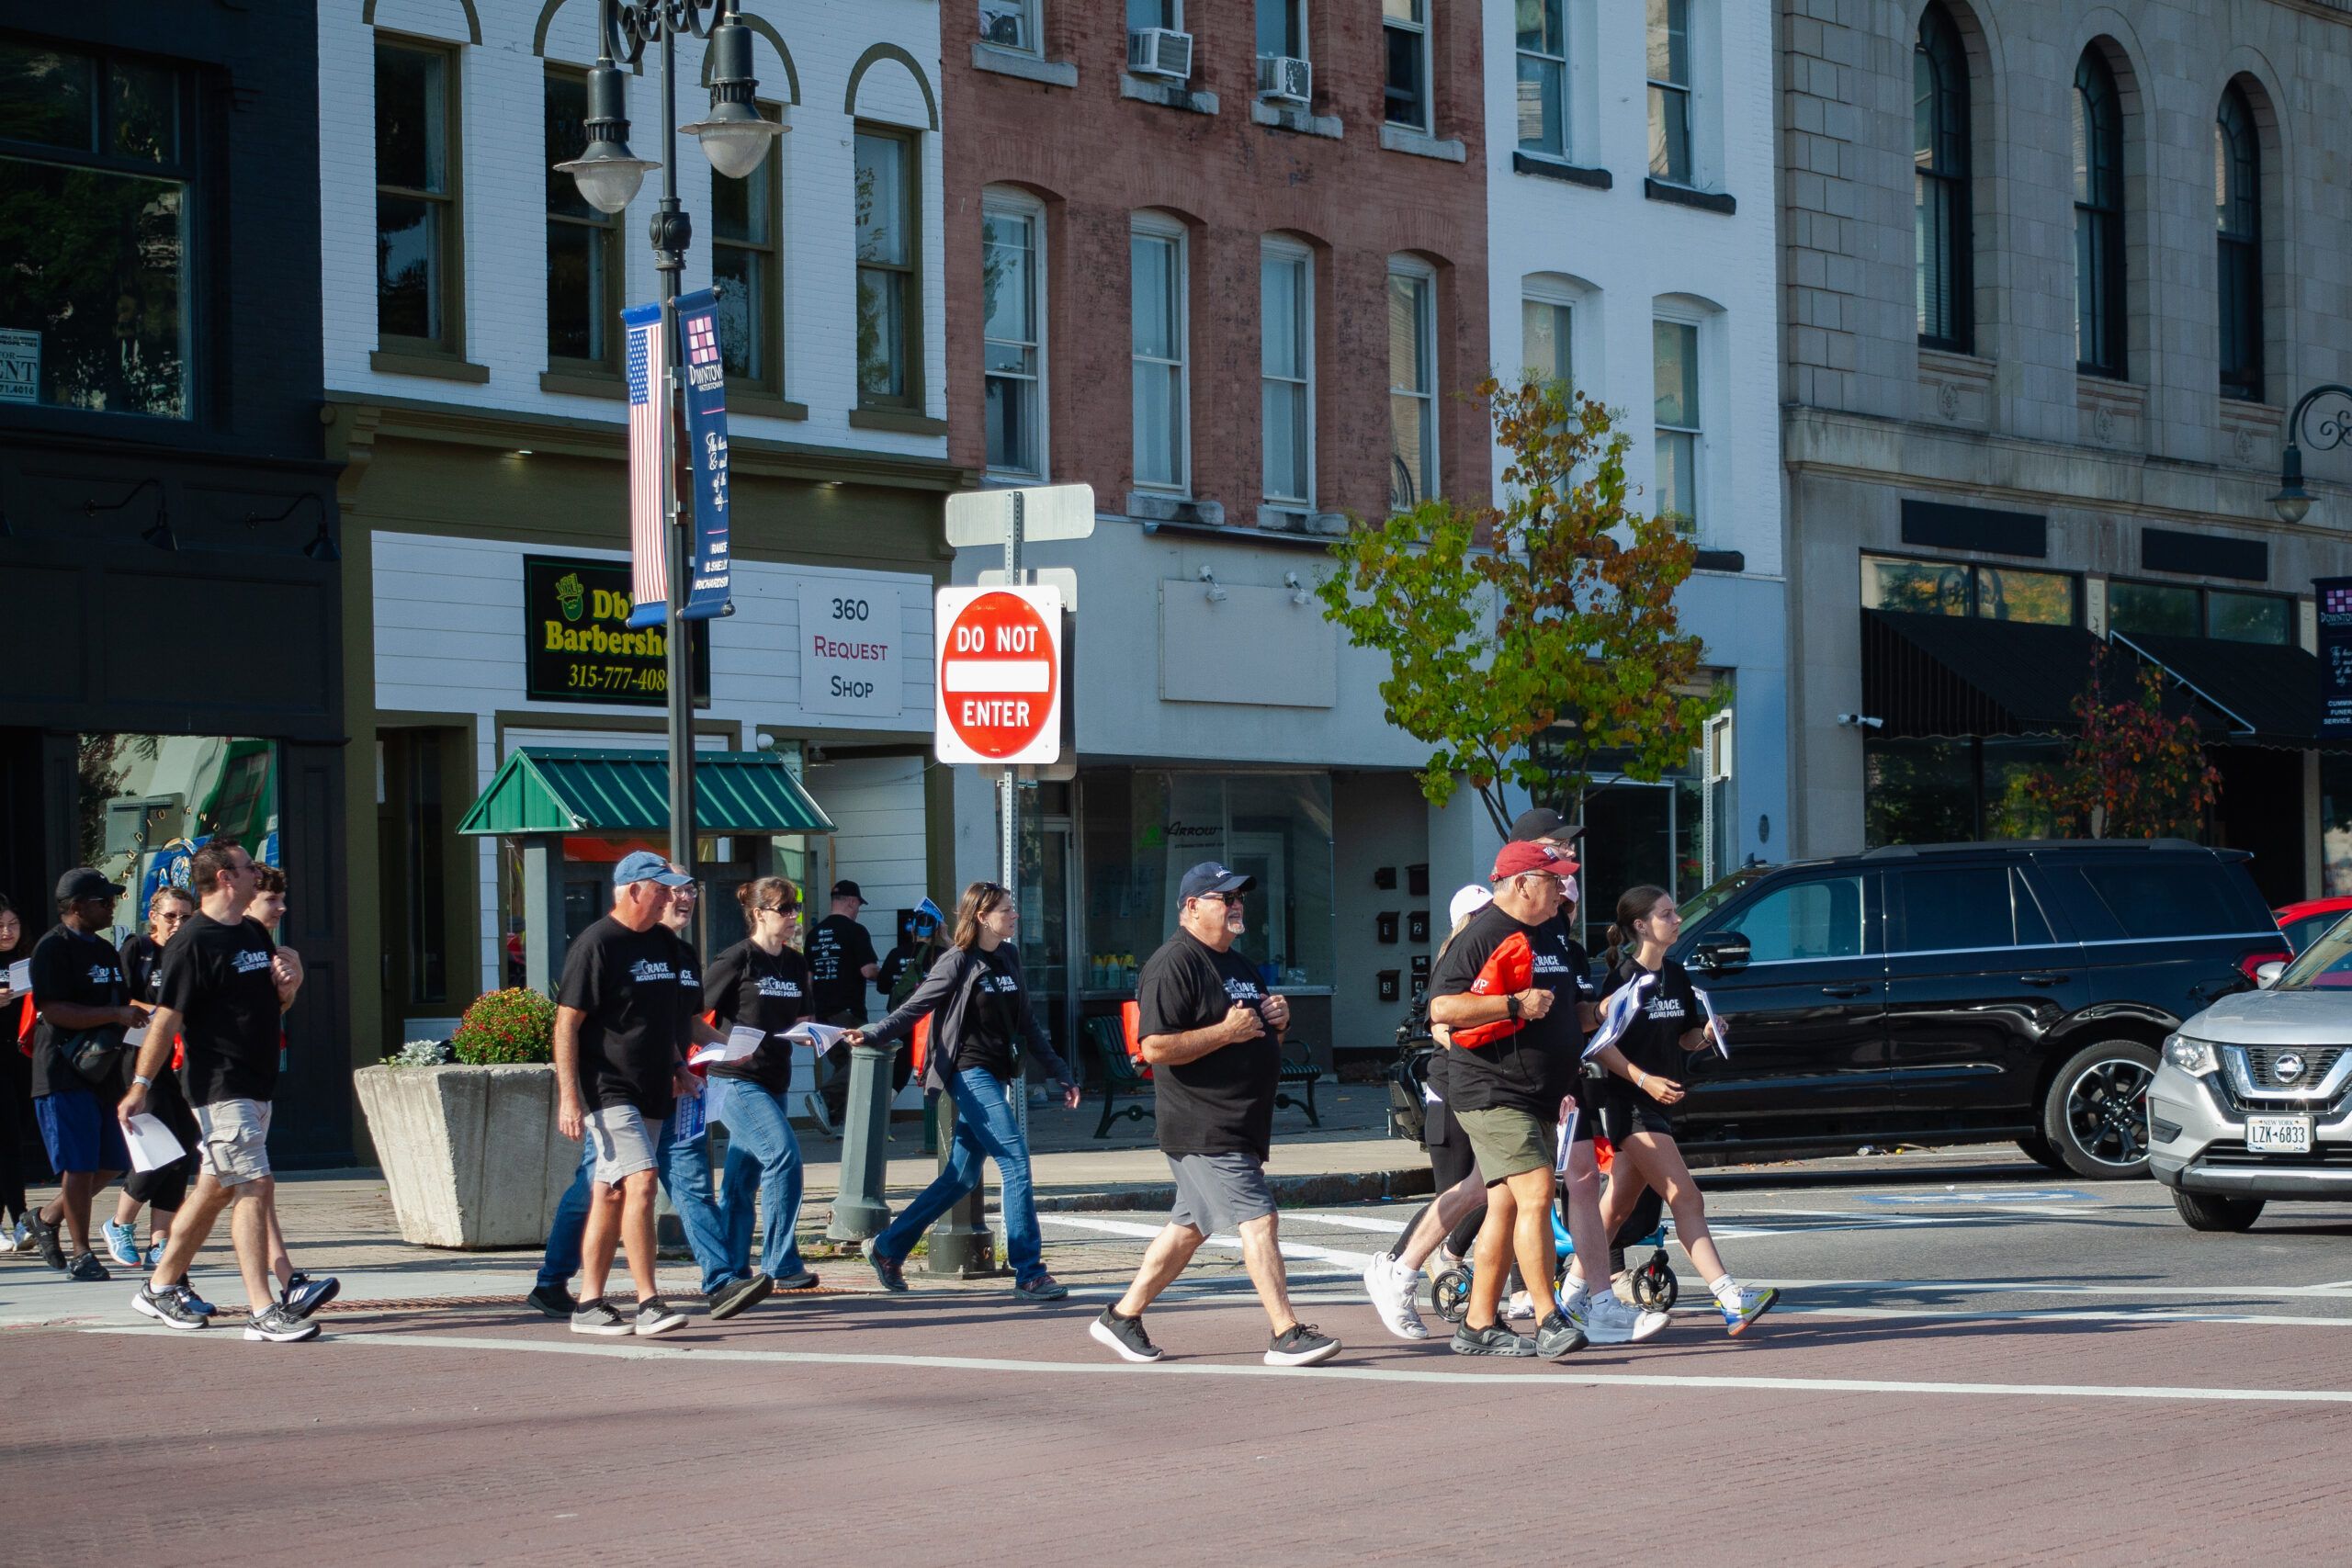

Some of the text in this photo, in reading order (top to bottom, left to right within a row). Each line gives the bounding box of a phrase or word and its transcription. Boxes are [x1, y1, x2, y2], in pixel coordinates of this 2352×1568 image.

[593, 589, 634, 620] Db'
[831, 598, 869, 621] 360
[546, 620, 694, 658] Barbersh
[957, 626, 1038, 652] DO NOT
[569, 663, 669, 691] 315-777-408
[963, 701, 1030, 728] ENTER
[1415, 923, 1422, 934] 2
[1537, 955, 1559, 965] RACE
[98, 966, 119, 977] RAE
[647, 963, 669, 974] RACE
[681, 970, 693, 980] CE
[775, 981, 798, 991] RACE
[1657, 999, 1681, 1010] RACE
